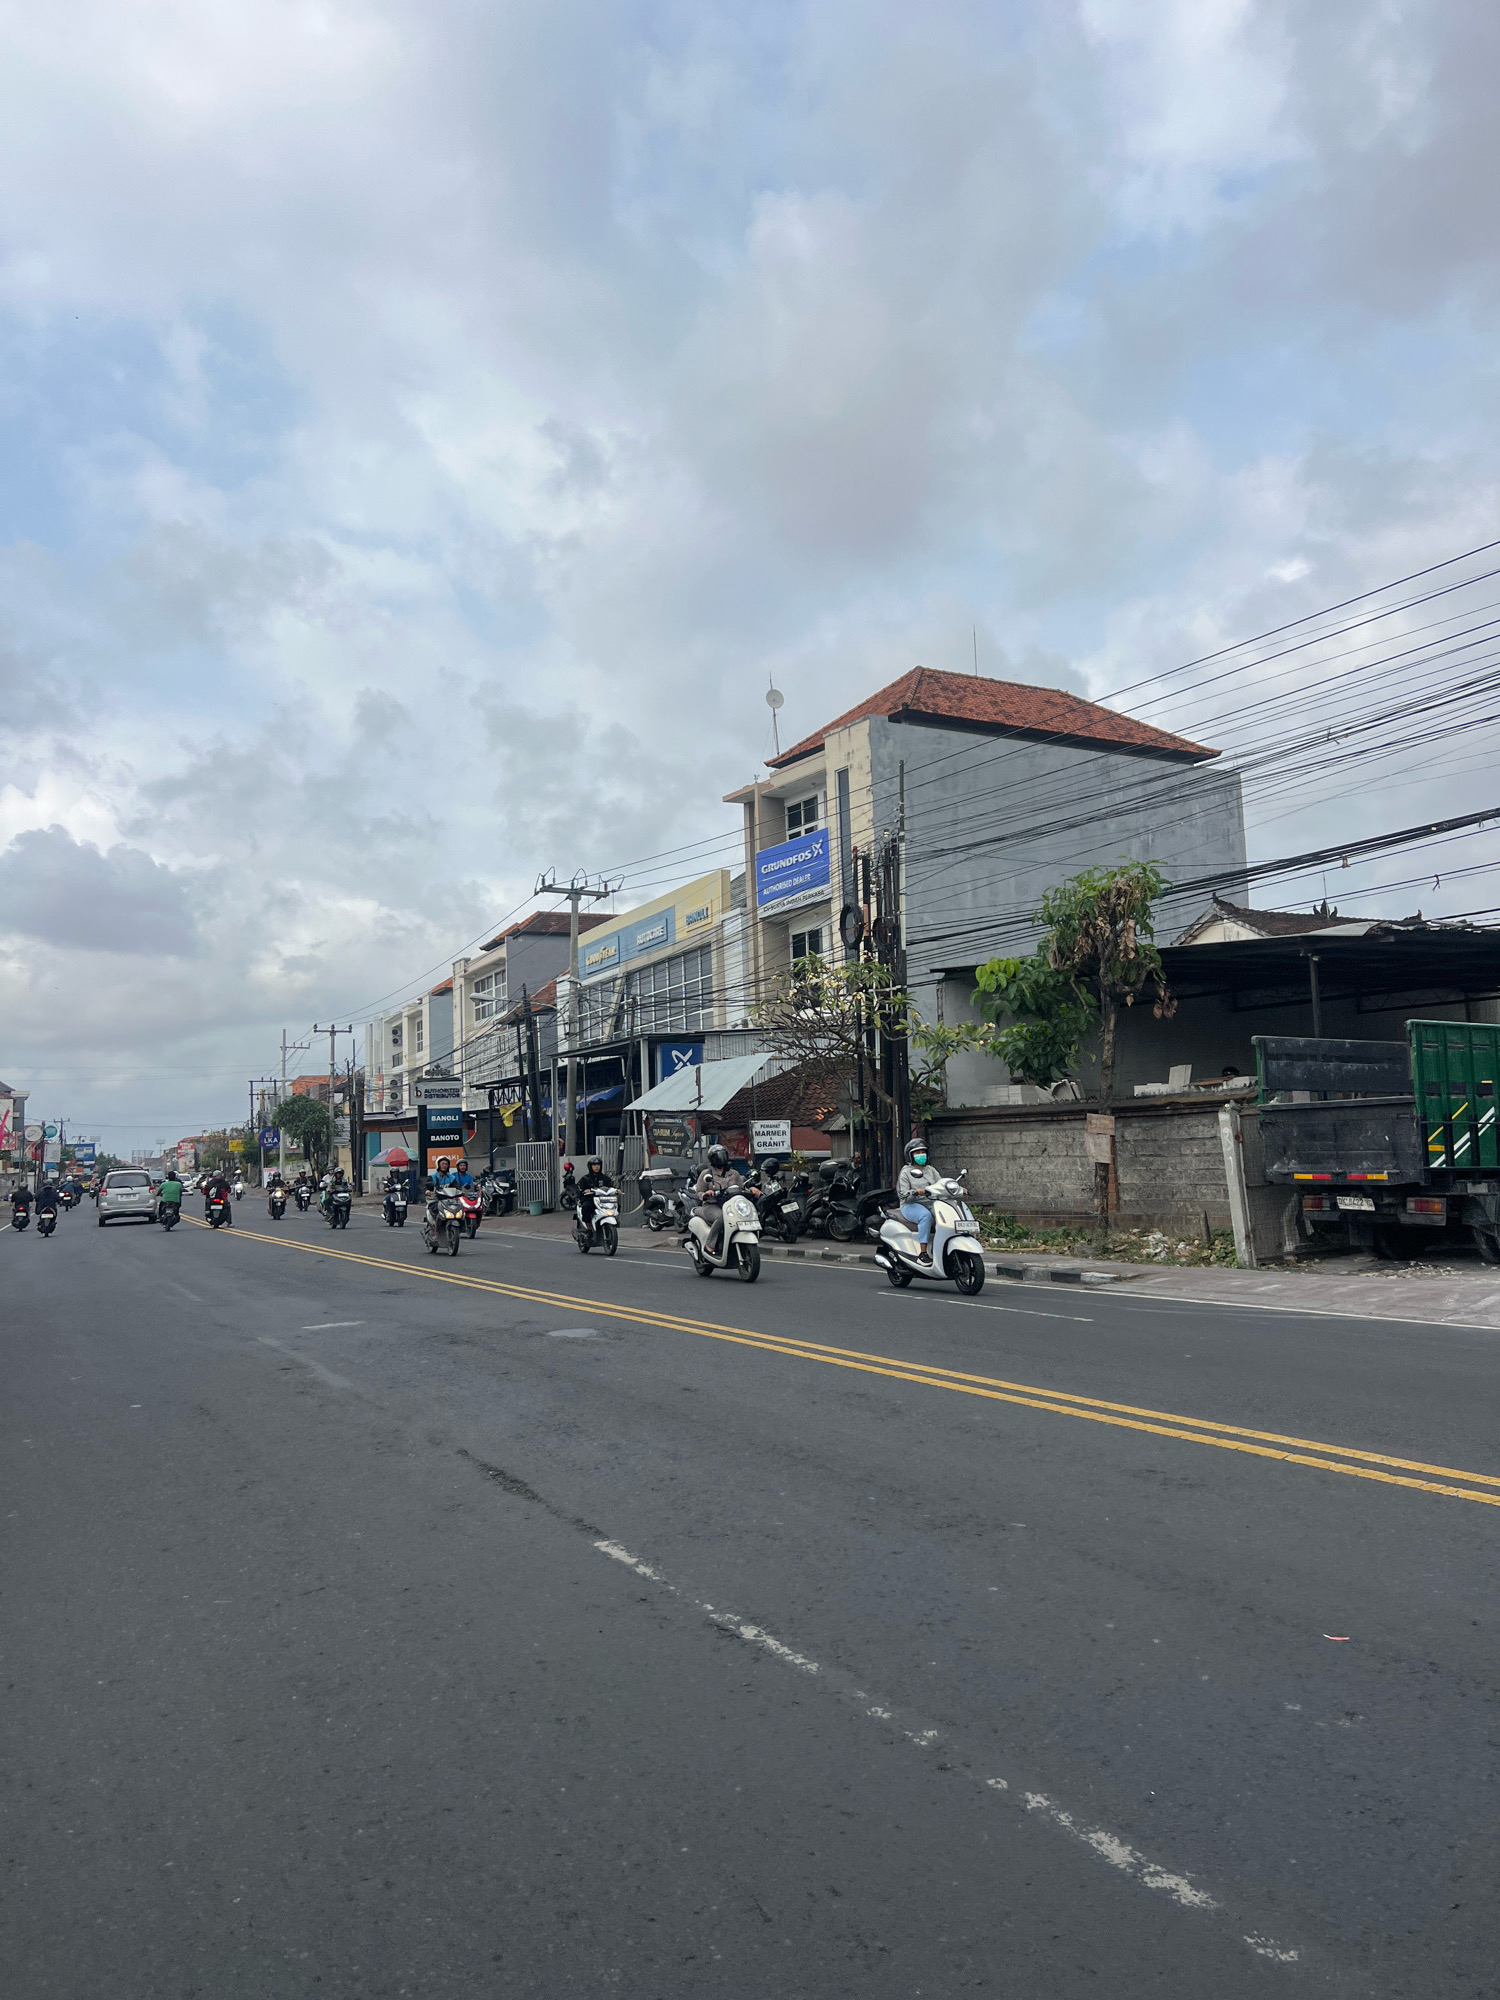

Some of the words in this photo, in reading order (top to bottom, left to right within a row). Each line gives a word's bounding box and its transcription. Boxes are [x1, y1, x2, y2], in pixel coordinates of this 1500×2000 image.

[761, 850, 812, 874] GRUNDFOS
[762, 878, 793, 896] AUTHORISED
[792, 873, 811, 886] DEALER
[756, 1140, 786, 1148] GRANIT
